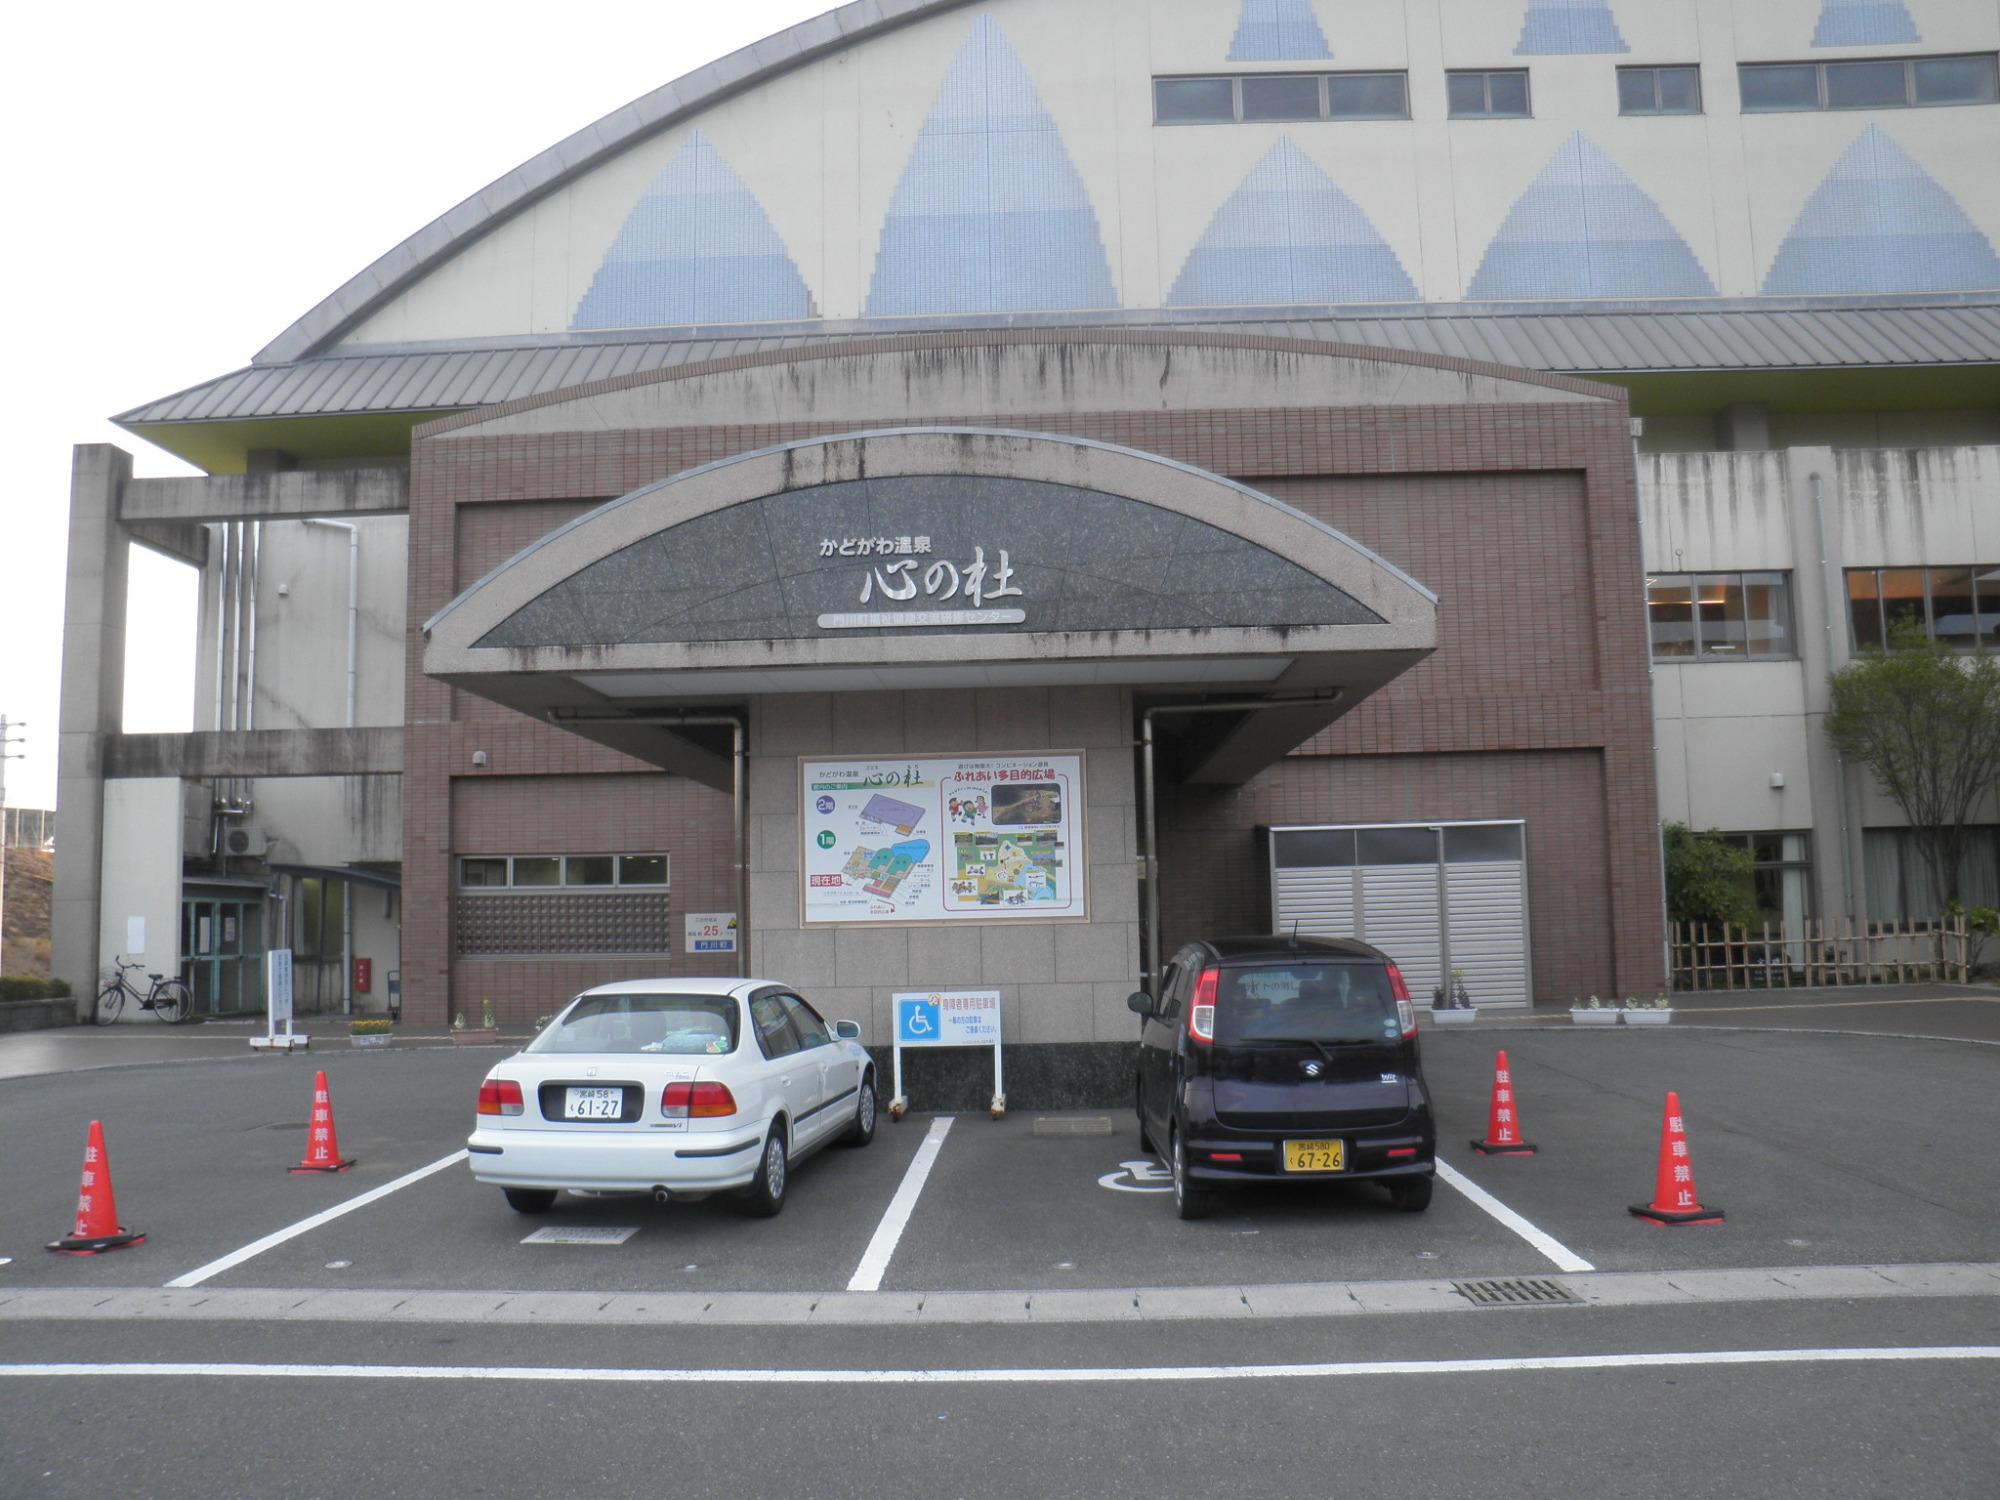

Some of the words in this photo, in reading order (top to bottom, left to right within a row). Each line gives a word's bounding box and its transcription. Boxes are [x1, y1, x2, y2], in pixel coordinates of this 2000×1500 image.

[820, 536, 931, 556] かどがわ温泉
[859, 545, 1023, 608] 心の杜
[819, 769, 859, 778] かどがわ温泉
[863, 768, 923, 787] 心の杜
[954, 769, 1056, 782] ふれあい多目的広場
[811, 875, 841, 886] 現在地
[704, 925, 719, 936] 25
[577, 1099, 619, 1115] 61-27
[1495, 1070, 1512, 1141] 駐車禁止
[314, 1090, 329, 1160] 駐車禁止
[1297, 1152, 1340, 1168] 67-26
[1669, 1116, 1692, 1206] 駐車禁止
[73, 1146, 98, 1236] 駐車禁止
